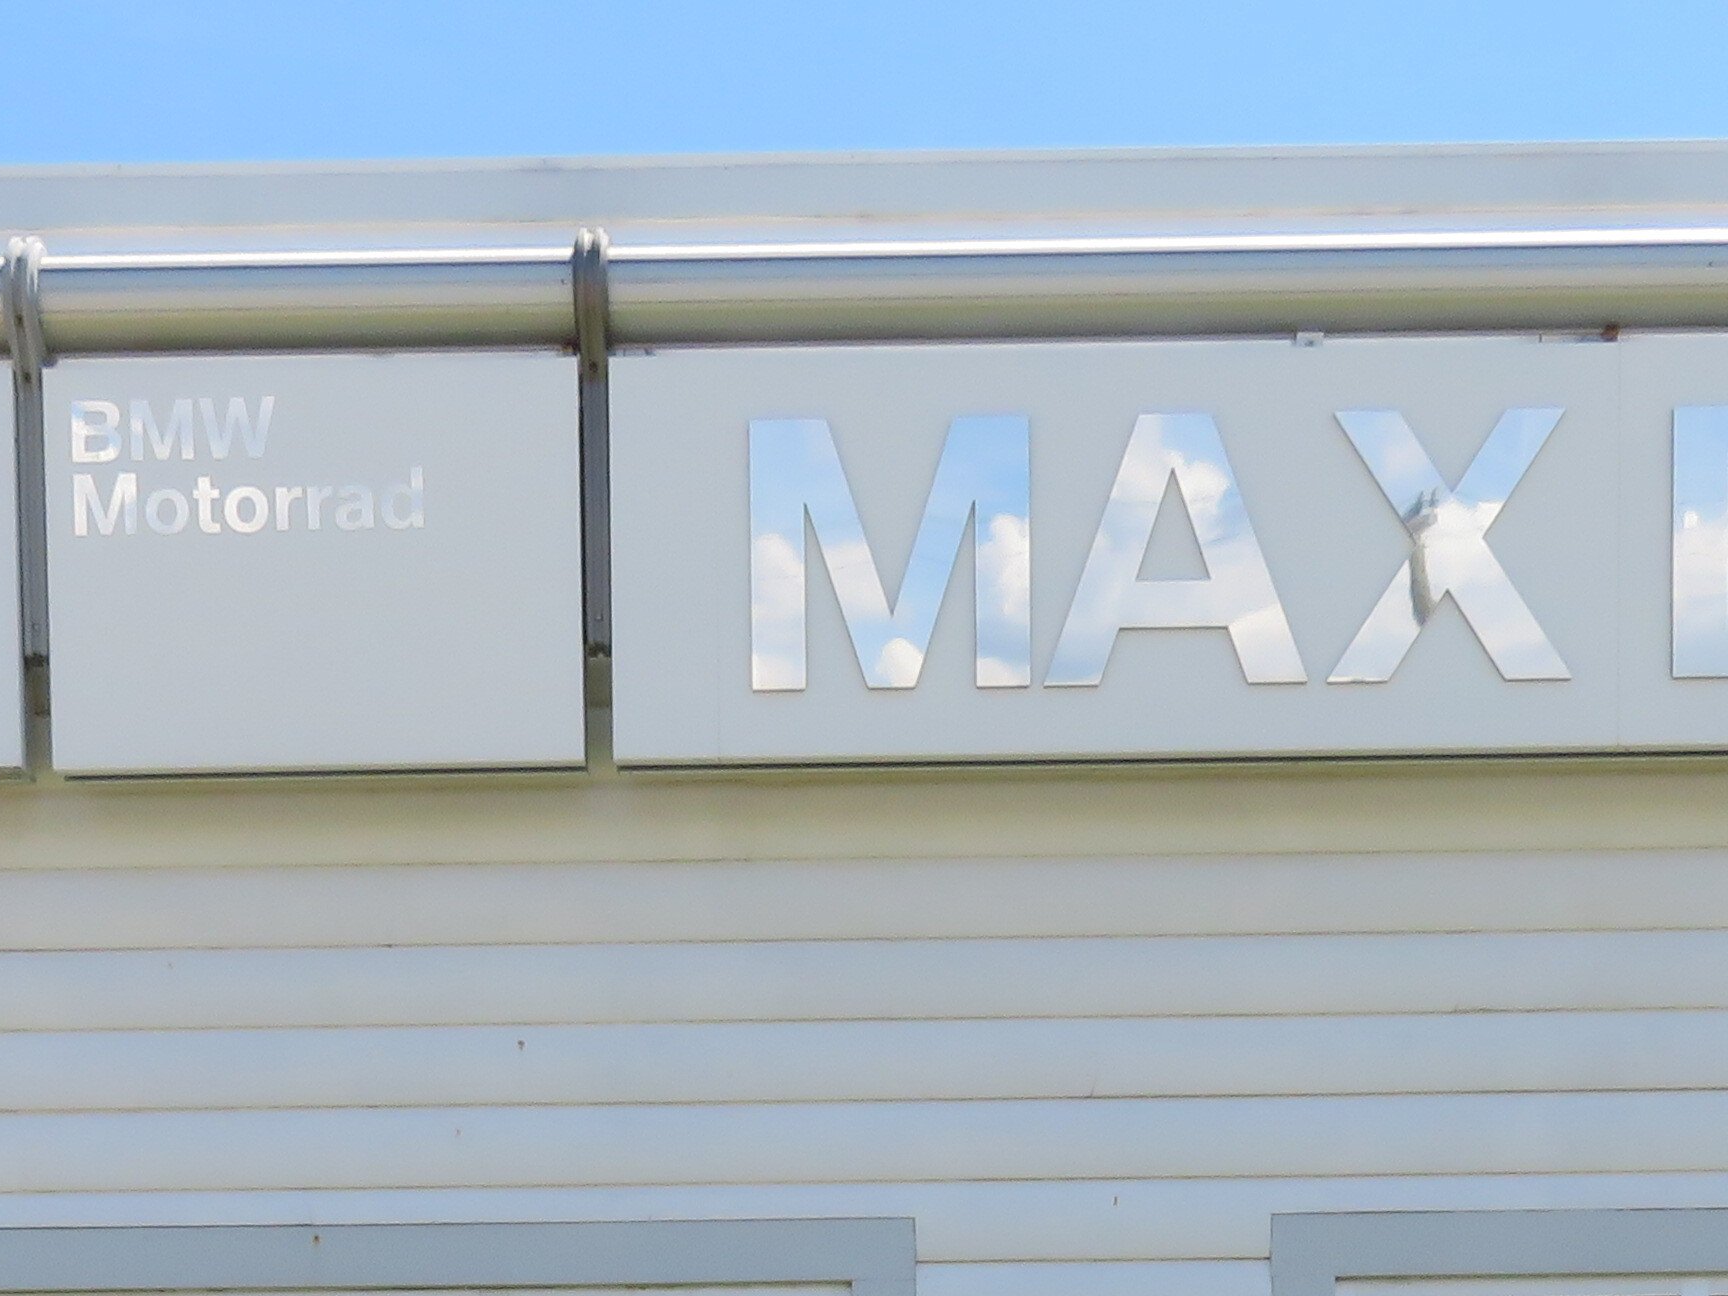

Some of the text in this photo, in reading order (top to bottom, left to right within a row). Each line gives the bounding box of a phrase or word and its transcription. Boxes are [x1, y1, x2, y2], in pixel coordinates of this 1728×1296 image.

[70, 395, 277, 465] BMW
[72, 466, 426, 538] Motorrad
[748, 406, 1573, 691] MAX
